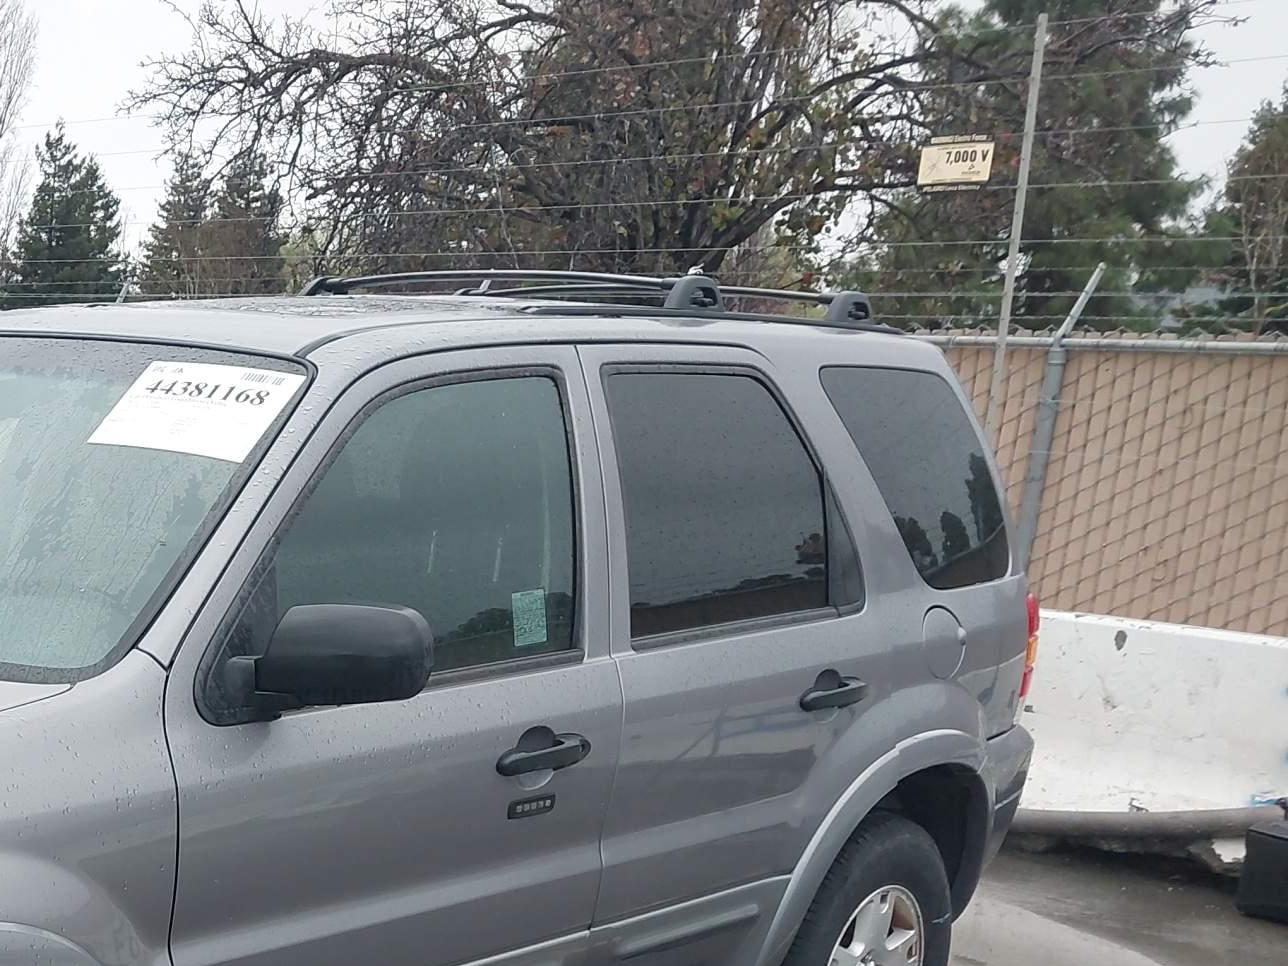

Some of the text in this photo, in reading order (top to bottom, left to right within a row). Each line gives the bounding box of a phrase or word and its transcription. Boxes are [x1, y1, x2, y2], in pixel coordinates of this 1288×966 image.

[945, 149, 990, 166] 7,000 V
[145, 379, 270, 405] 44381168
